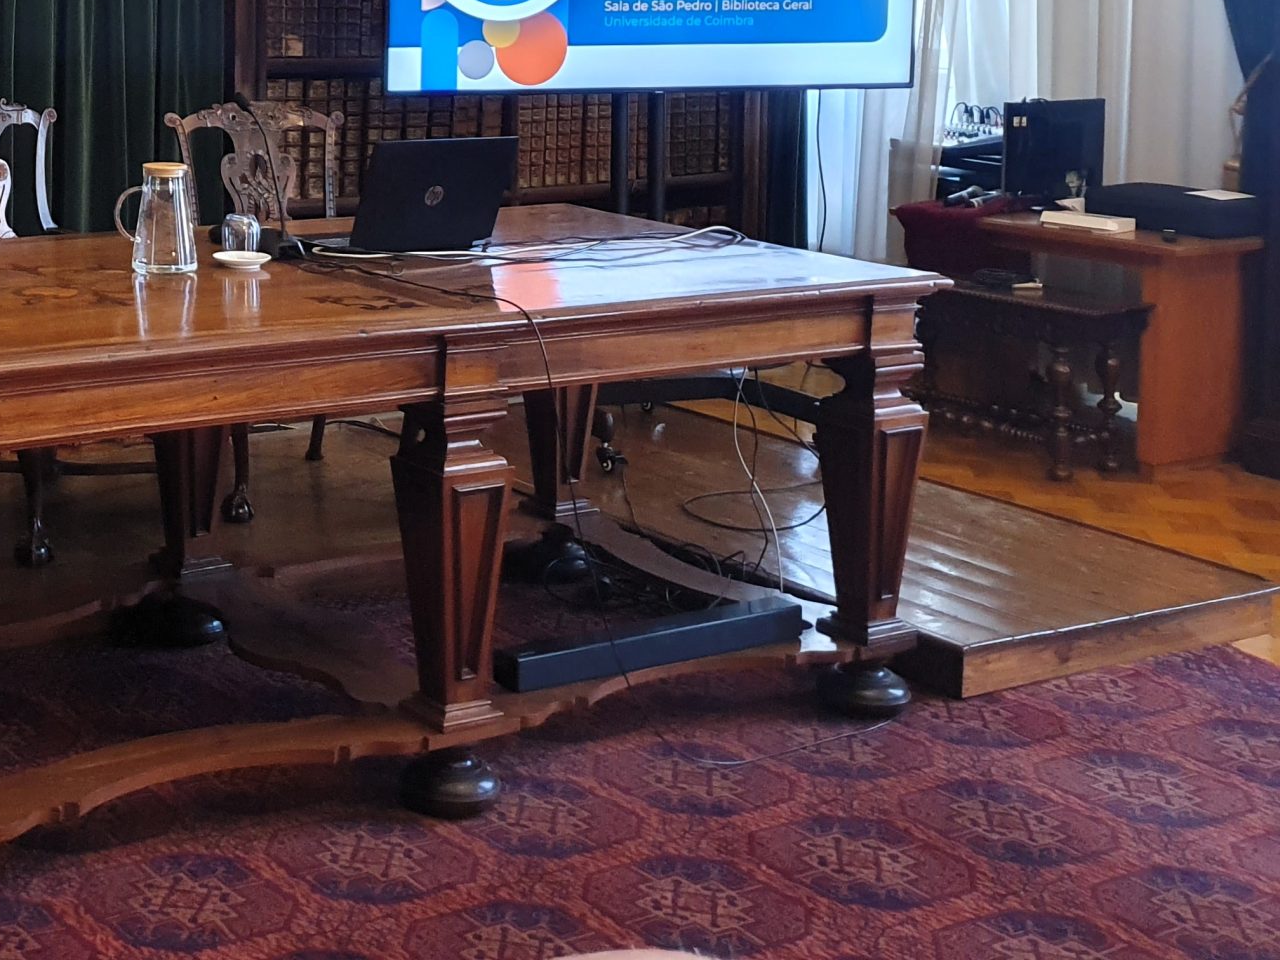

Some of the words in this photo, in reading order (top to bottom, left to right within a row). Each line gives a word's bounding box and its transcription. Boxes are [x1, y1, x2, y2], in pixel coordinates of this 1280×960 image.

[604, 0, 629, 12] Sala
[632, 0, 648, 12] de
[651, 0, 674, 11] São
[676, 0, 712, 11] Pedro
[721, 0, 780, 11] Biblioteca
[782, 0, 813, 10] Geral
[604, 15, 683, 27] Universidade
[686, 15, 701, 26] de
[704, 14, 754, 26] Coimbra
